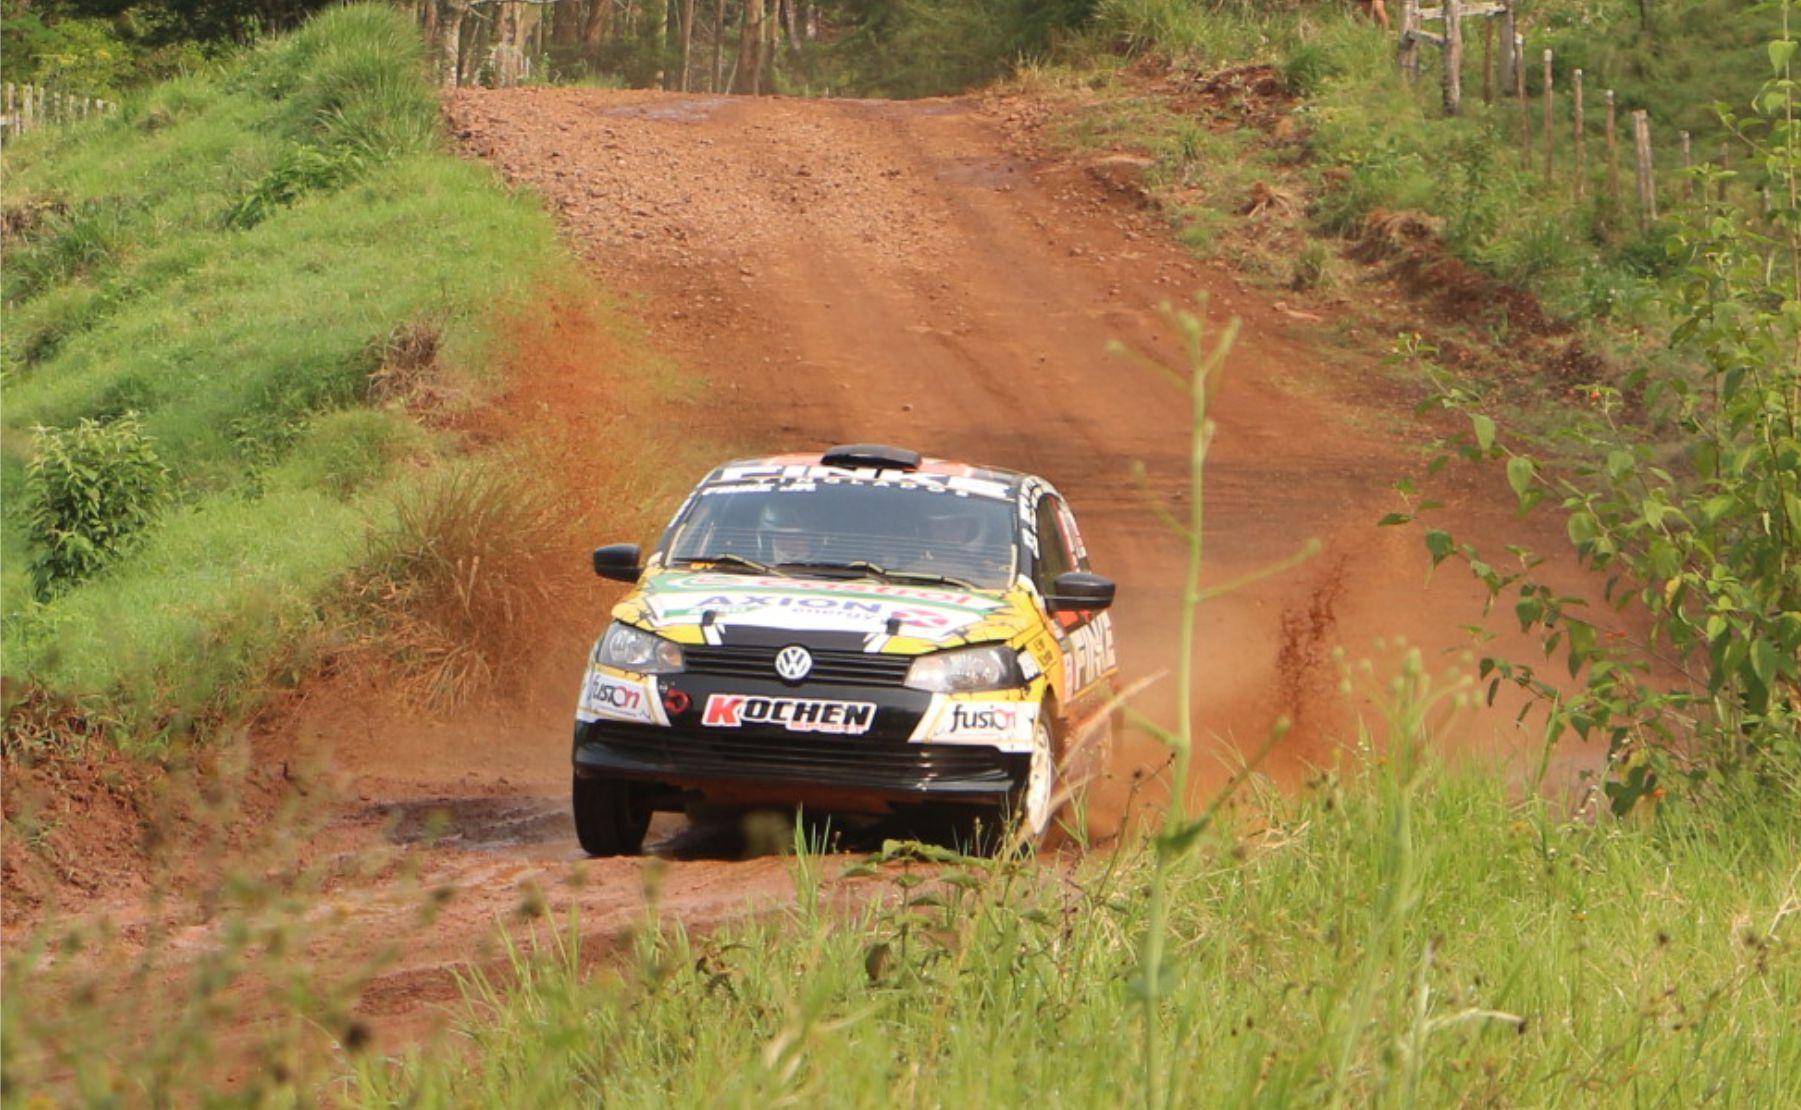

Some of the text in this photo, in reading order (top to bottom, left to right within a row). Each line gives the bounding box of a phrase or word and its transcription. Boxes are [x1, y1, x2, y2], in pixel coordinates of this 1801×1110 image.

[696, 595, 882, 613] AXION
[792, 607, 876, 621] energy
[705, 694, 876, 726] KOCHEN
